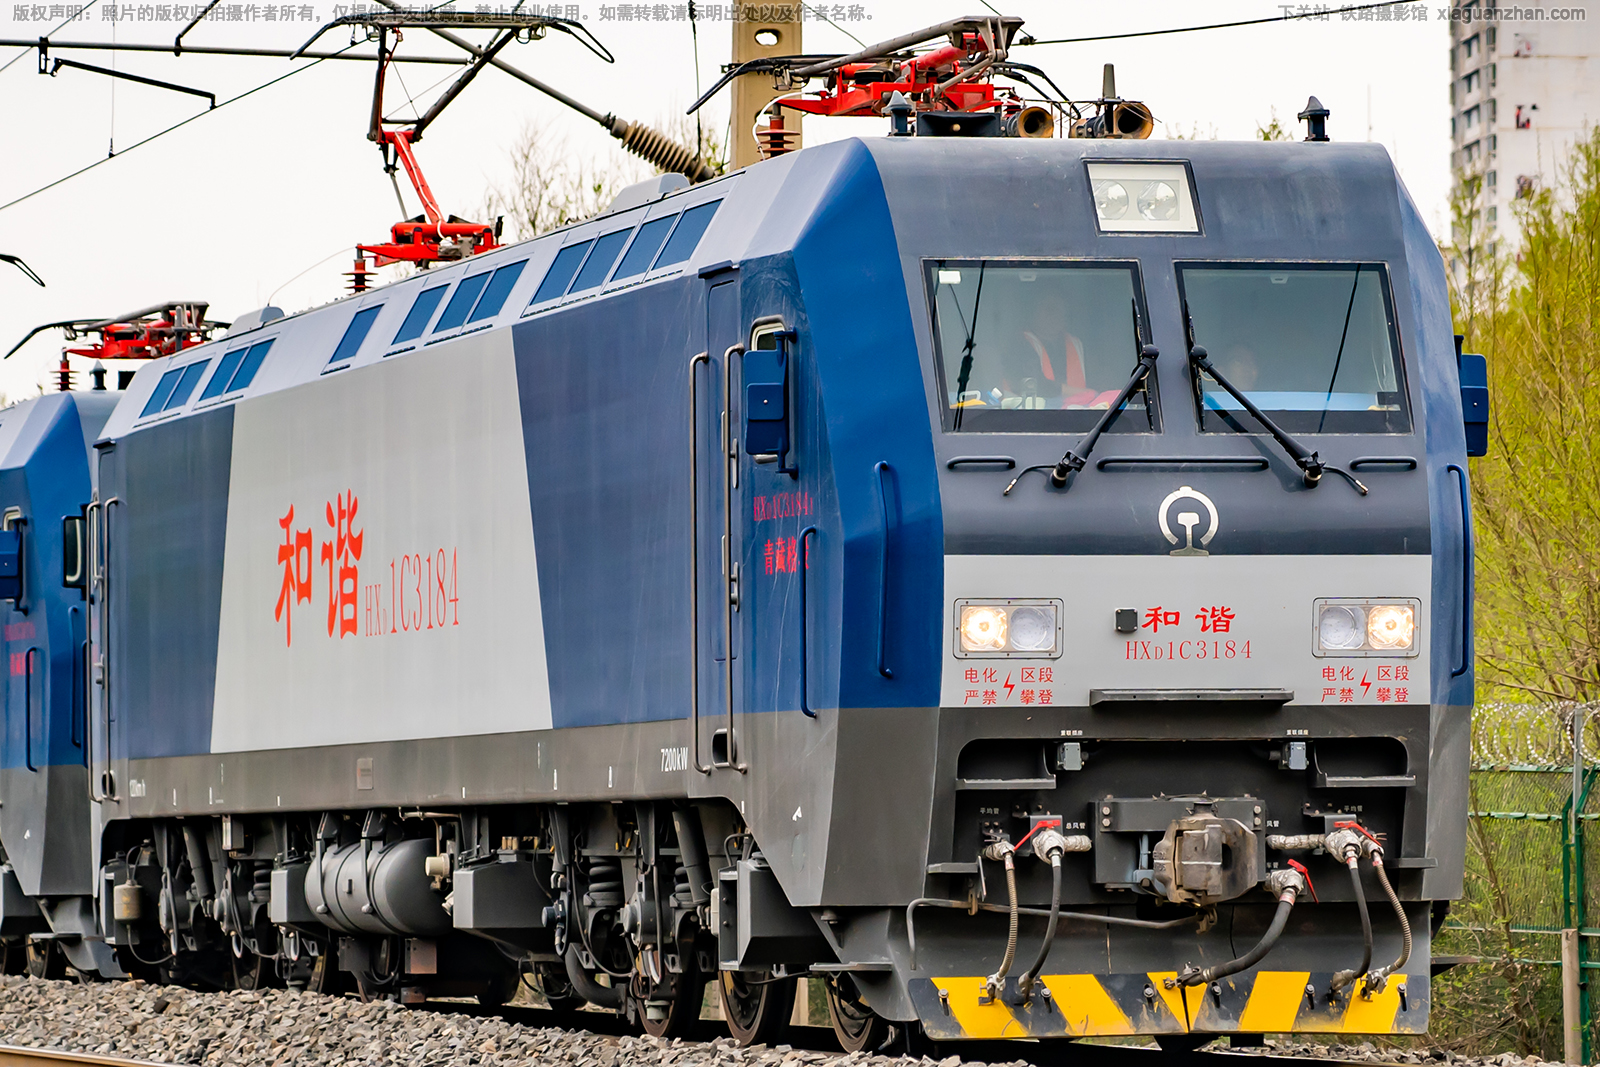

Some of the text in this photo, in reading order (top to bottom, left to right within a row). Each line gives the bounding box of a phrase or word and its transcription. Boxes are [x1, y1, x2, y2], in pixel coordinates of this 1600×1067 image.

[764, 536, 809, 575] 青藏格
[275, 488, 363, 648] 和谐
[1141, 605, 1236, 633] 和谐
[964, 667, 1053, 683] 电化 区段
[1322, 665, 1409, 681] 电化 区段
[963, 689, 1053, 705] 严禁 攀登
[1321, 687, 1409, 703] 严禁 攀登
[660, 747, 689, 772] 7200kW
